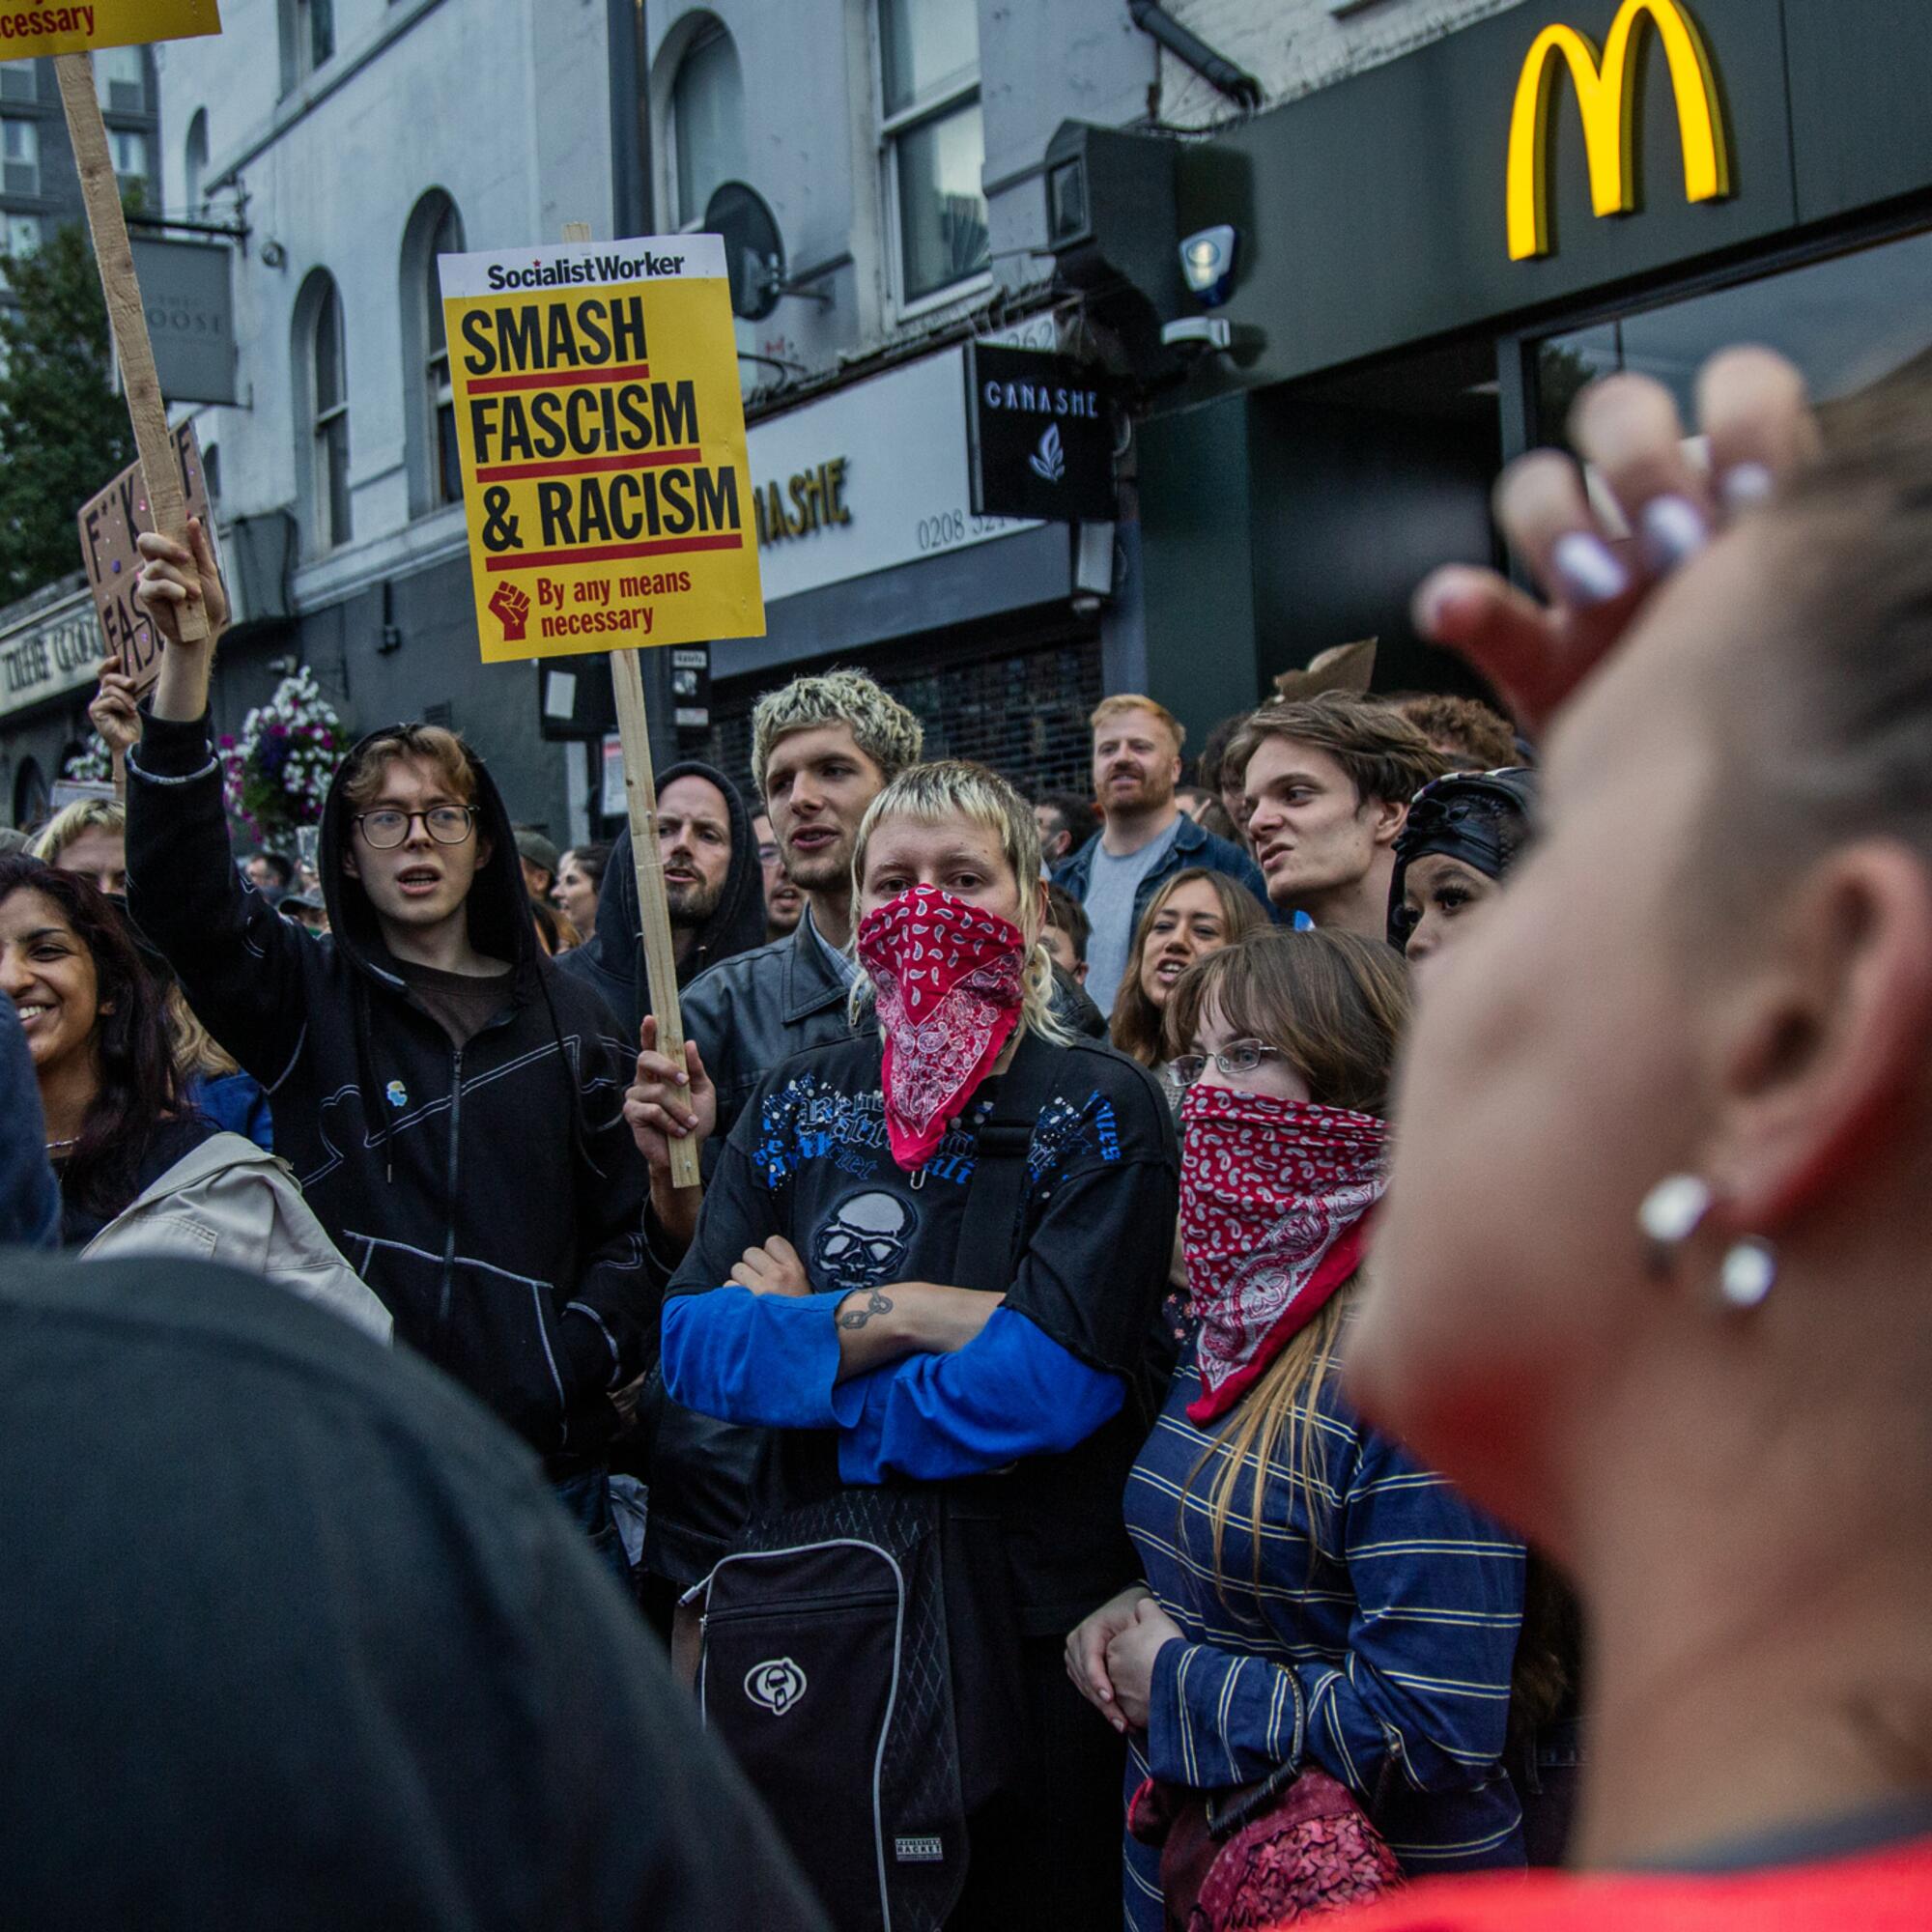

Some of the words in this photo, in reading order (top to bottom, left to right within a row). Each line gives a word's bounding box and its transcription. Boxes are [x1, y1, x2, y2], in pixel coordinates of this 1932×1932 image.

[0, 5, 95, 40] cessary
[461, 296, 648, 376] SMASH
[469, 380, 700, 464] FASCISM
[482, 485, 524, 553] &
[537, 466, 742, 547] RACISM
[918, 508, 965, 550] 0208
[537, 577, 565, 611] By
[573, 579, 611, 606] any
[619, 570, 692, 598] means
[541, 606, 654, 638] necessary
